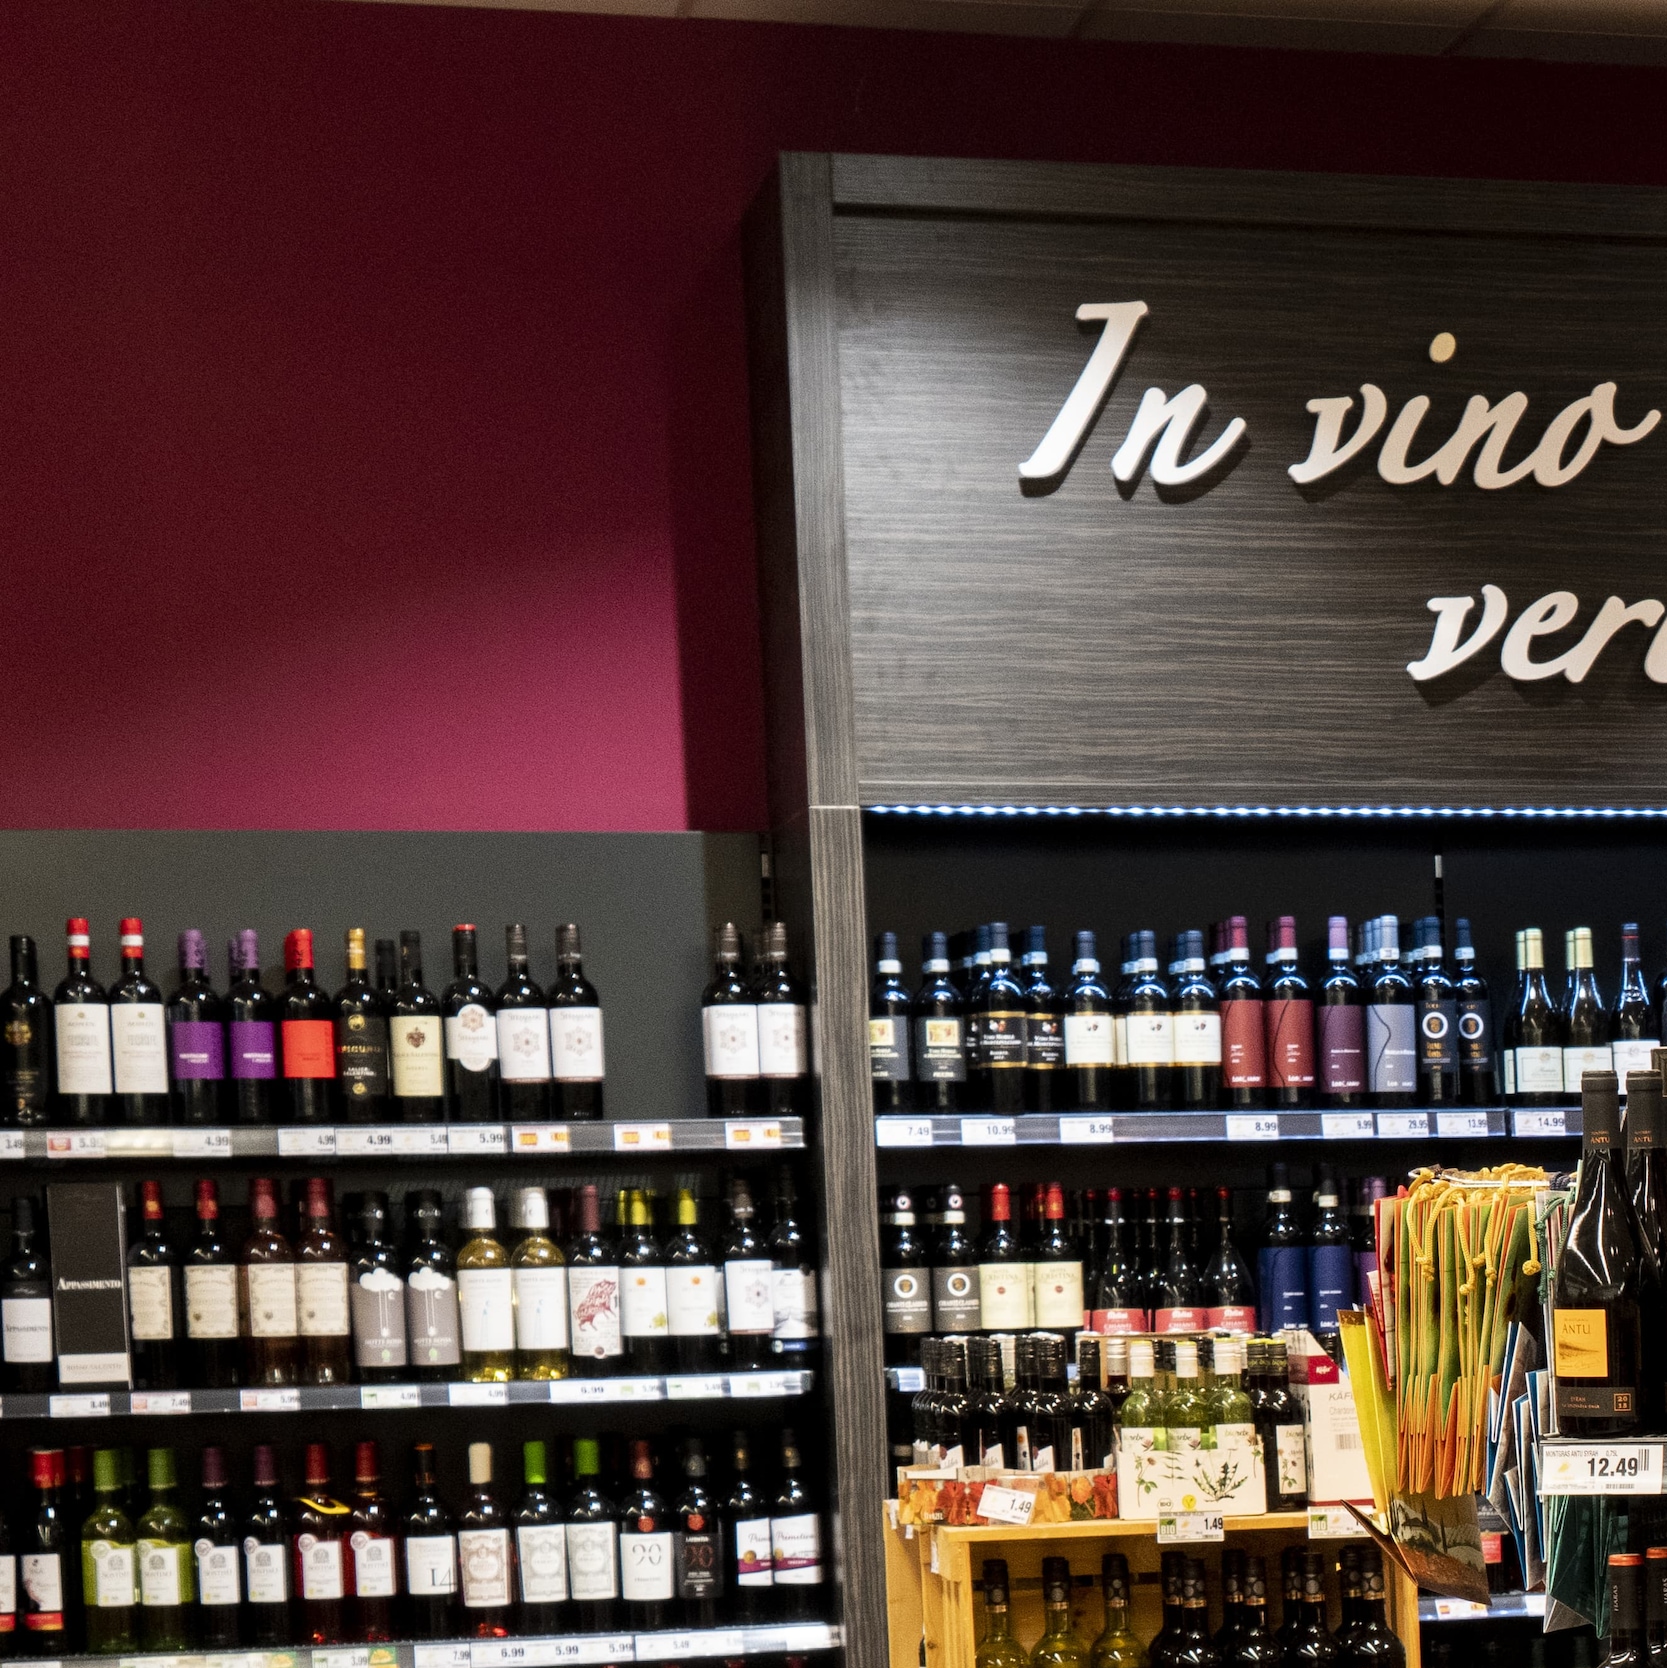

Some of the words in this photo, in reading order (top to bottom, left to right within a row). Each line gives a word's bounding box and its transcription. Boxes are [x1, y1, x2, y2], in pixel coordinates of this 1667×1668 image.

[1019, 298, 1247, 486] In
[1289, 331, 1661, 489] vino
[1538, 1118, 1565, 1128] 14.99
[1588, 1458, 1638, 1477] 12.49
[1010, 1499, 1032, 1514] 1.49
[1204, 1517, 1223, 1530] 1.49
[1160, 1525, 1176, 1534] BIO
[501, 1648, 524, 1657] 6.99
[556, 1645, 578, 1655] 5.99
